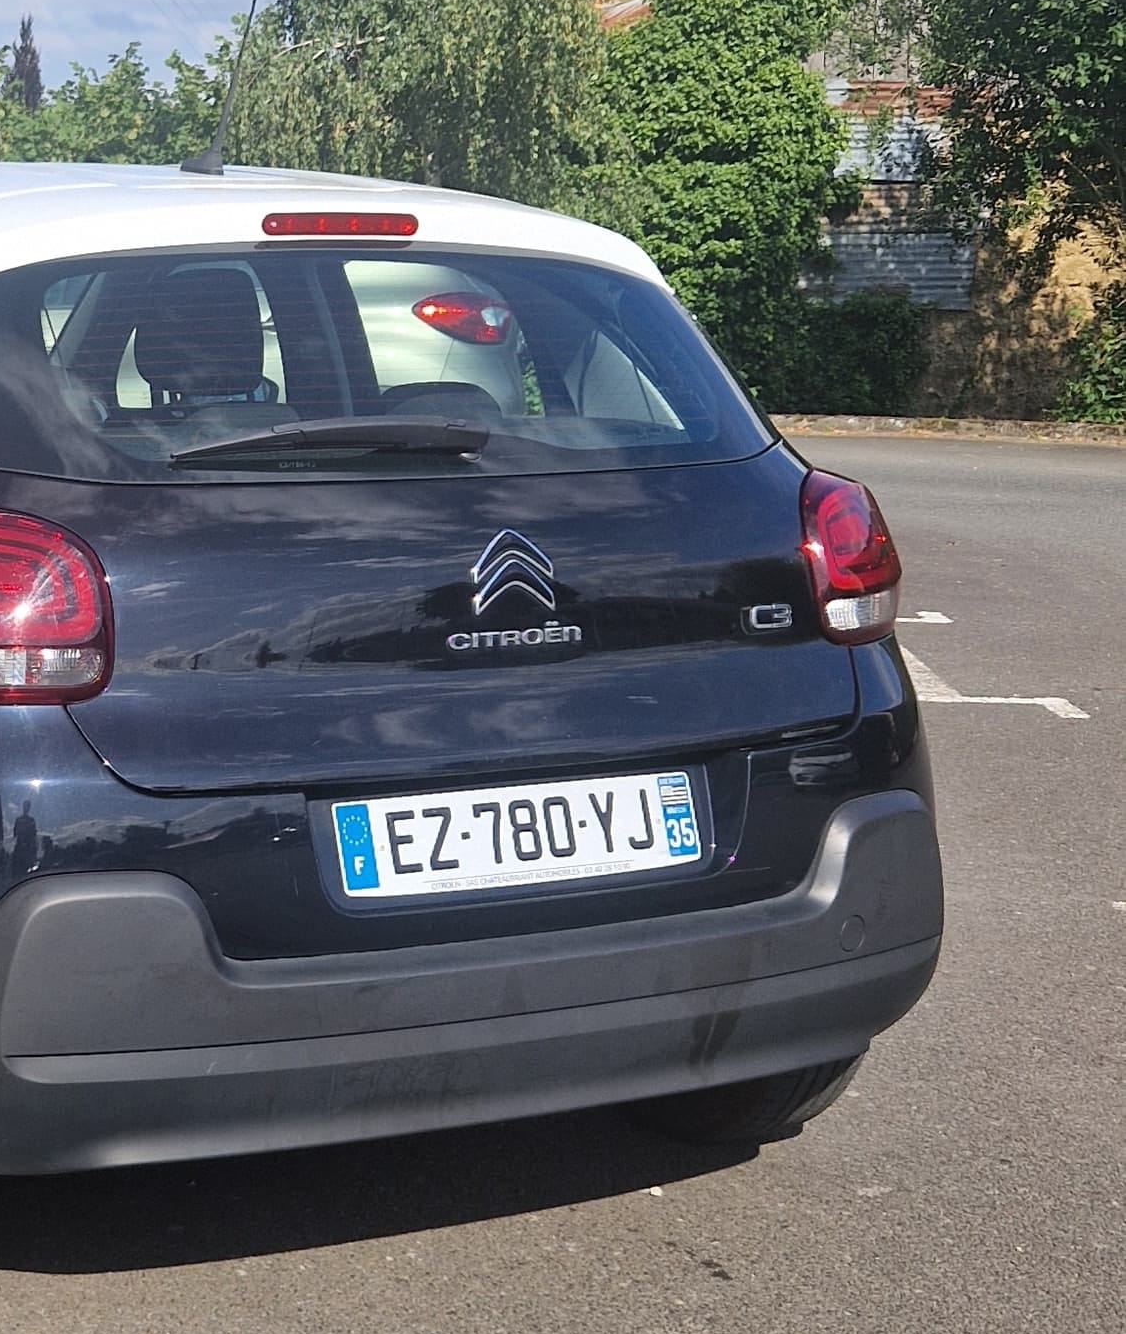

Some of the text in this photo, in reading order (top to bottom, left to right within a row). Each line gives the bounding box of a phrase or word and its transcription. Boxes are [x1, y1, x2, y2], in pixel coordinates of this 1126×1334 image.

[750, 603, 793, 629] C3
[385, 788, 654, 874] EZ-780-YJ
[667, 817, 695, 848] 35
[354, 856, 365, 876] F
